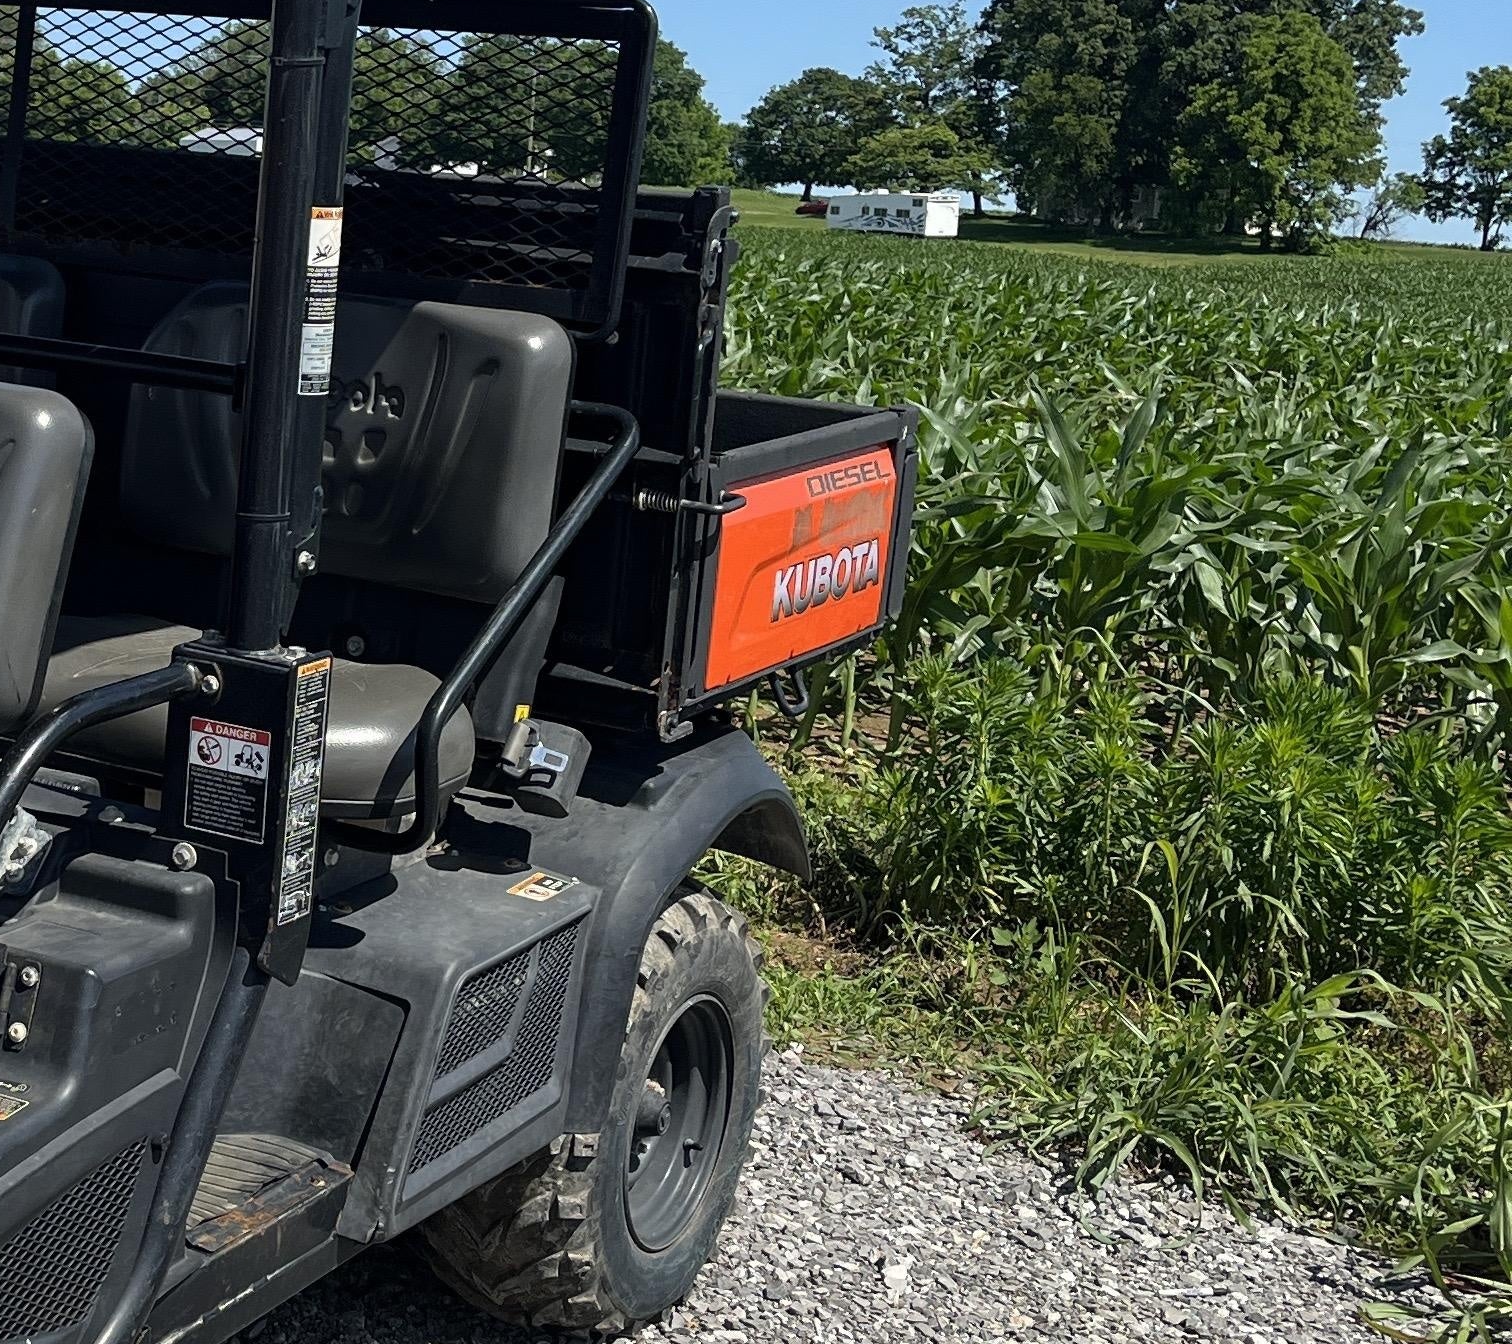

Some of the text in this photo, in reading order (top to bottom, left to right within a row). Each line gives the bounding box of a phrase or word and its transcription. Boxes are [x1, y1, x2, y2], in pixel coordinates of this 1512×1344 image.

[806, 460, 892, 498] DIESEL
[770, 537, 880, 624] KUBOTA
[215, 724, 257, 743] DANGER
